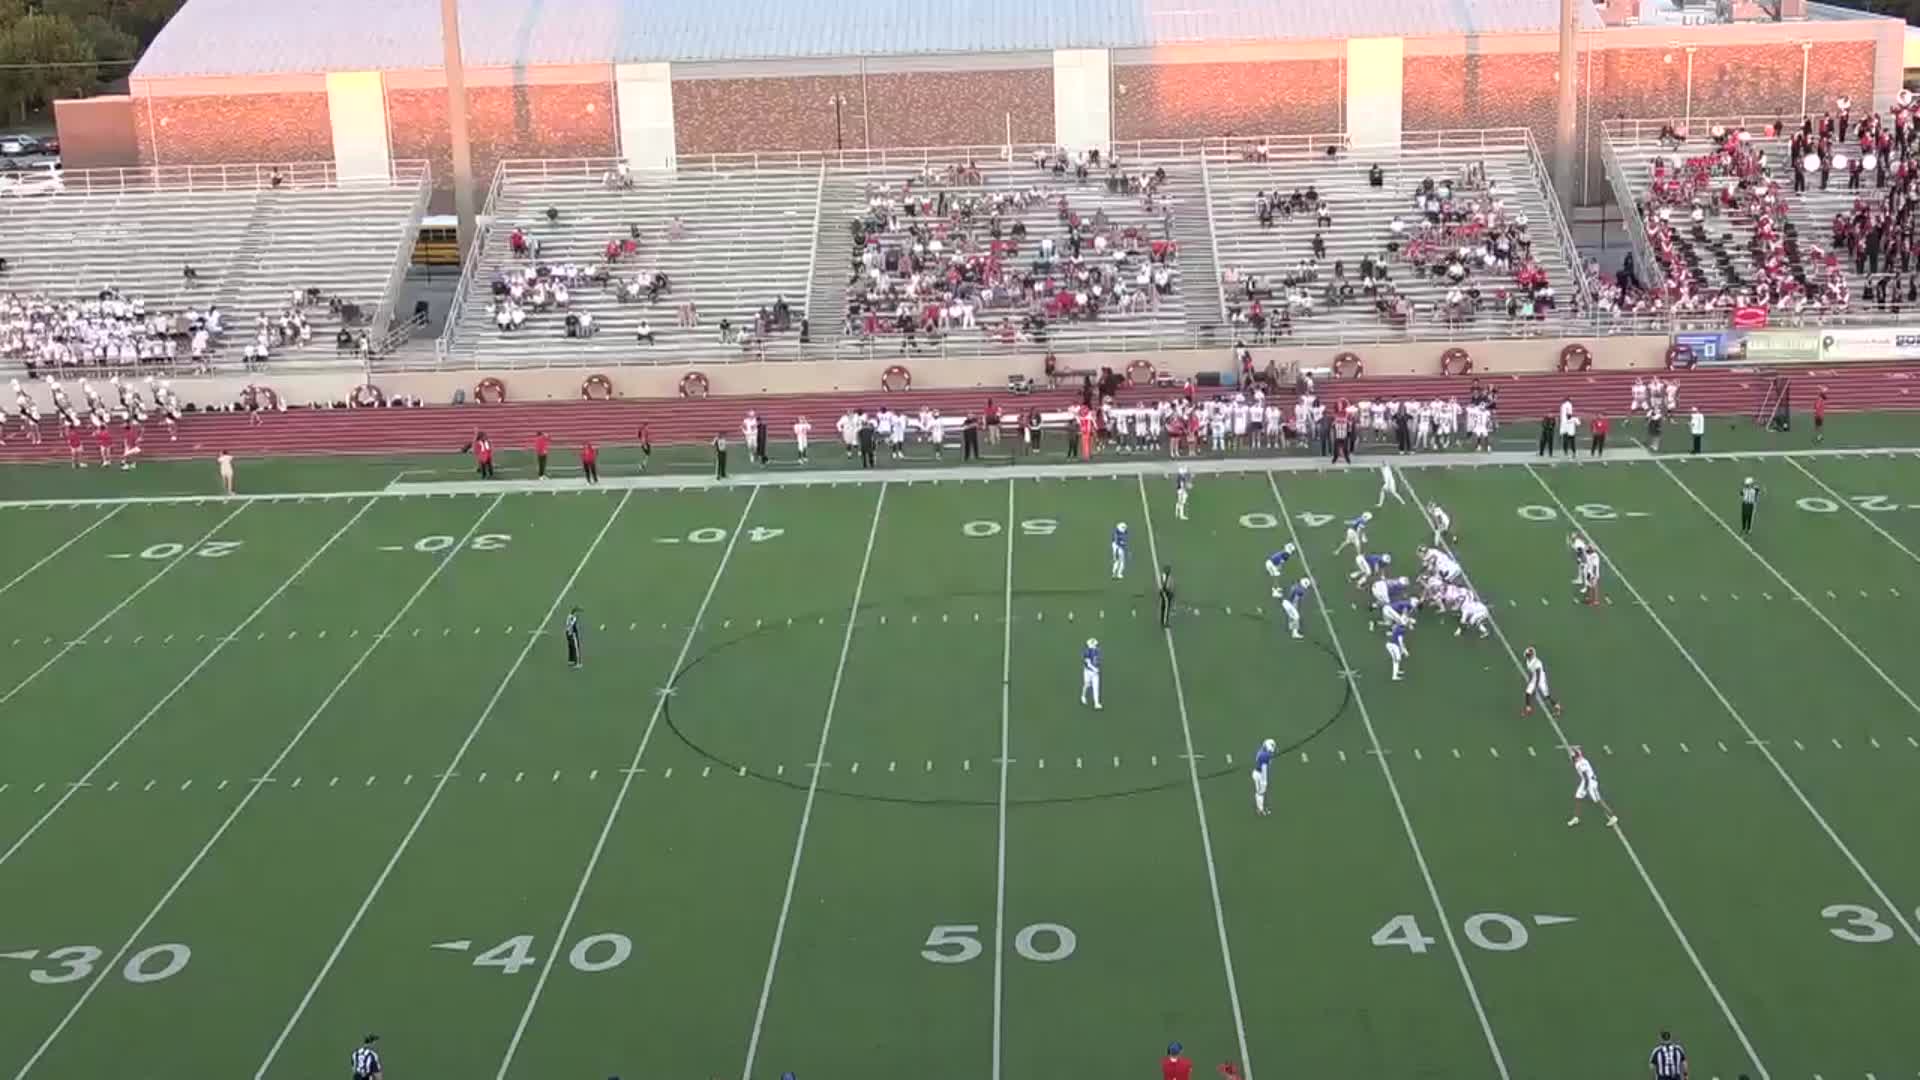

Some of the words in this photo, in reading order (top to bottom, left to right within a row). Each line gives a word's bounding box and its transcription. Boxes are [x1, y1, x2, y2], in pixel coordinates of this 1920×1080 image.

[1517, 503, 1619, 520] 30
[1796, 496, 1899, 512] 20
[962, 519, 1059, 537] 50
[1239, 512, 1335, 528] 40
[414, 534, 511, 552] 30
[688, 527, 784, 543] 40
[140, 541, 243, 559] 20
[1820, 904, 1920, 942] 3
[1371, 912, 1529, 953] 40
[921, 923, 1076, 963] 50
[472, 933, 632, 974] 40
[29, 943, 192, 984] 30
